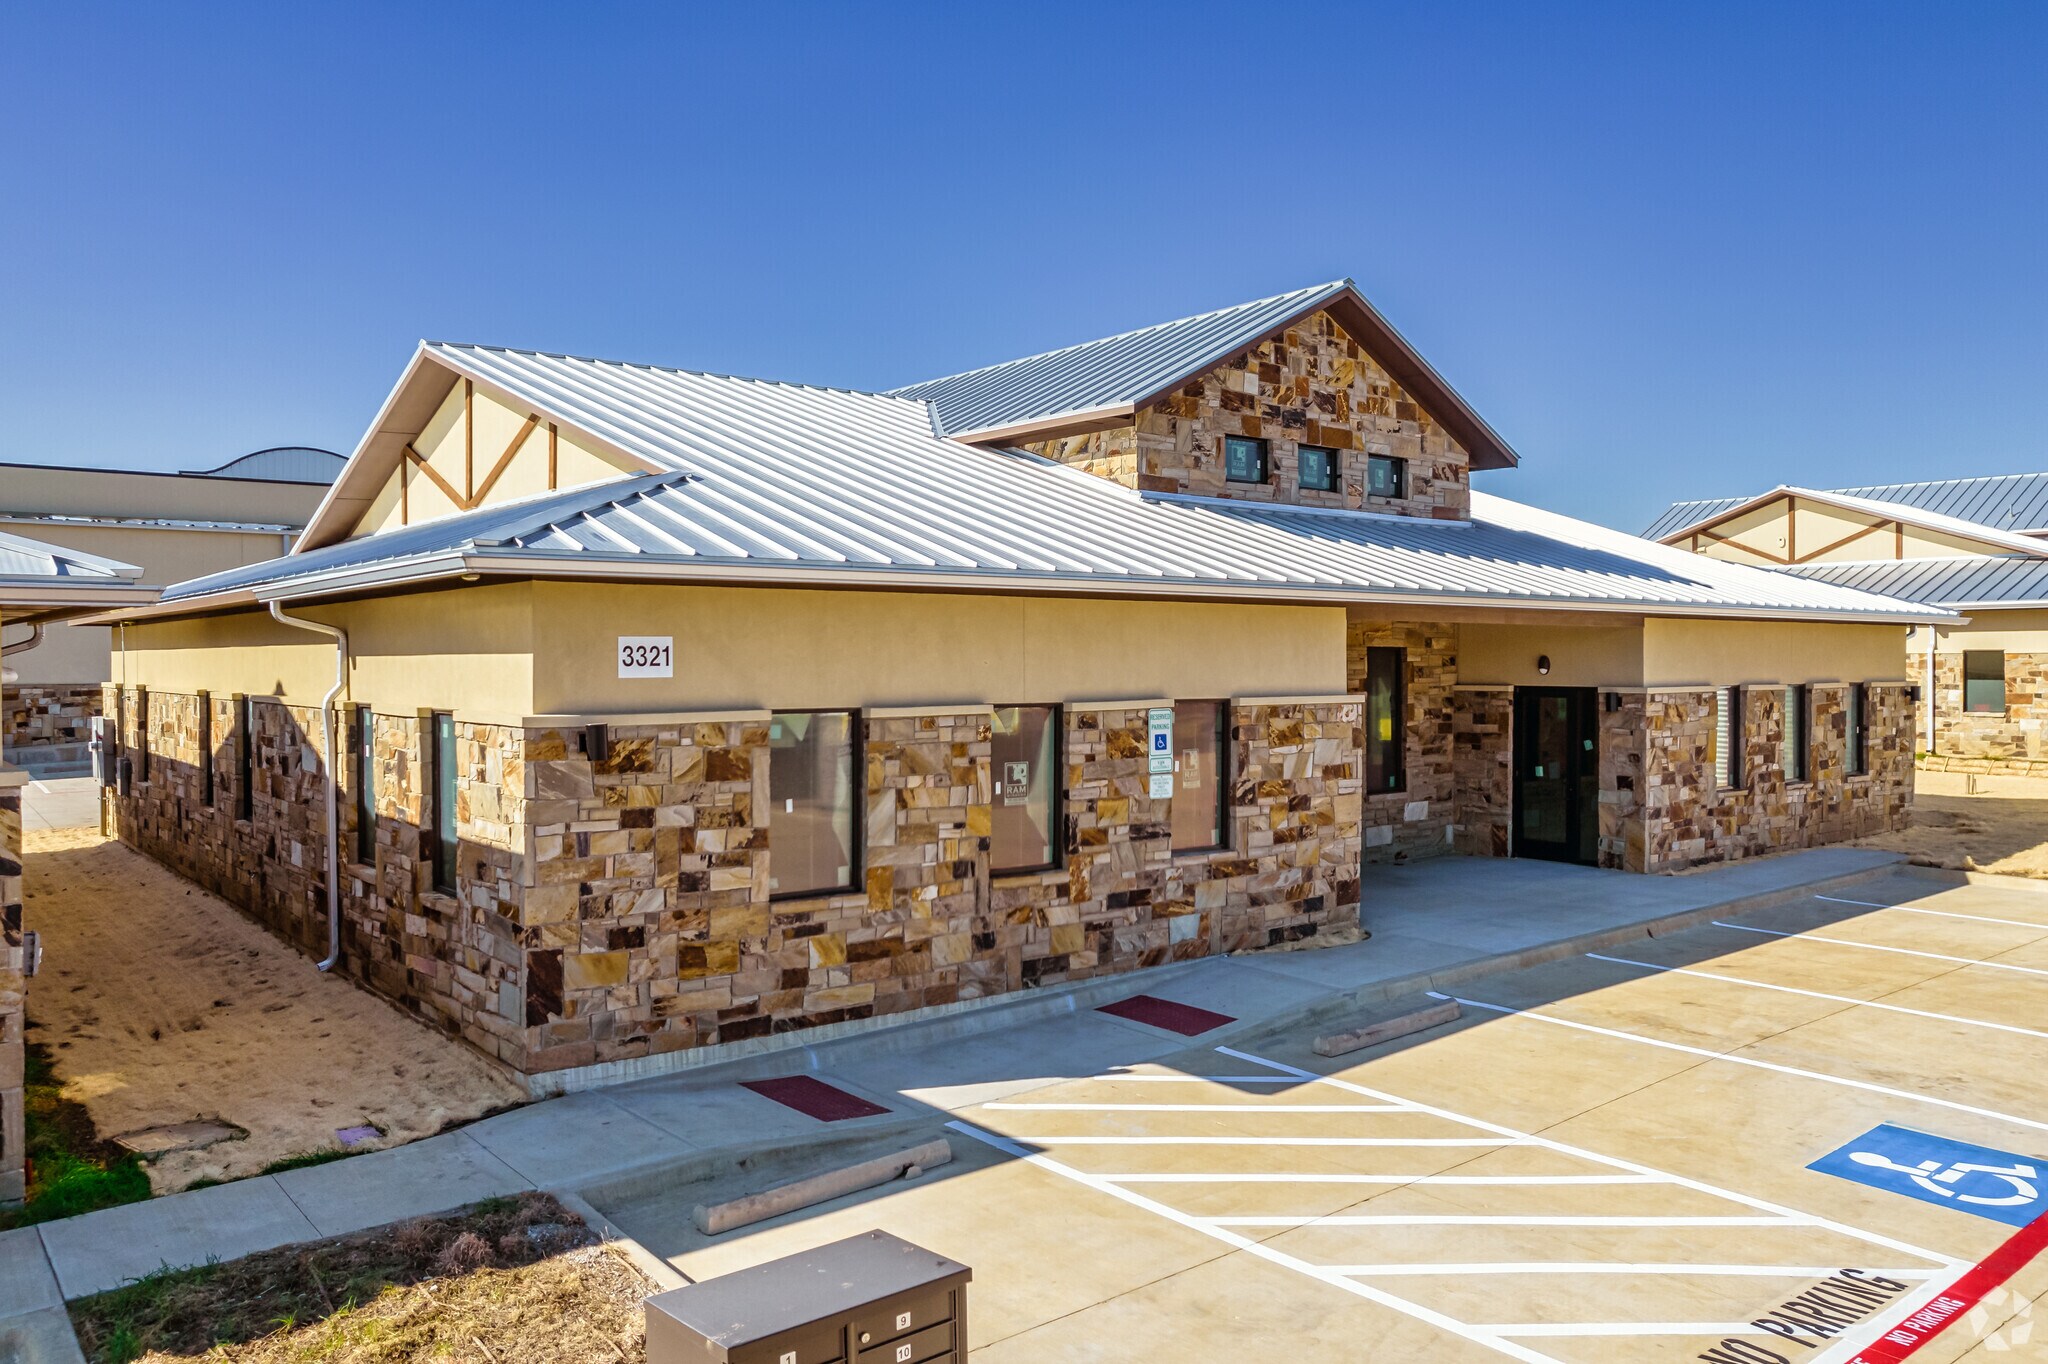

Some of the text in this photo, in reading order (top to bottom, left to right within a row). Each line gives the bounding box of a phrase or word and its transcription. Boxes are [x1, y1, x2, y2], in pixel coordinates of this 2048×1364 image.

[622, 645, 670, 667] 3321
[1006, 786, 1026, 794] RAM
[1750, 1268, 1909, 1349] PARKING
[900, 1316, 906, 1326] 9
[1884, 1296, 1966, 1347] NO PARKING
[898, 1347, 909, 1359] 10
[786, 1355, 790, 1364] 1
